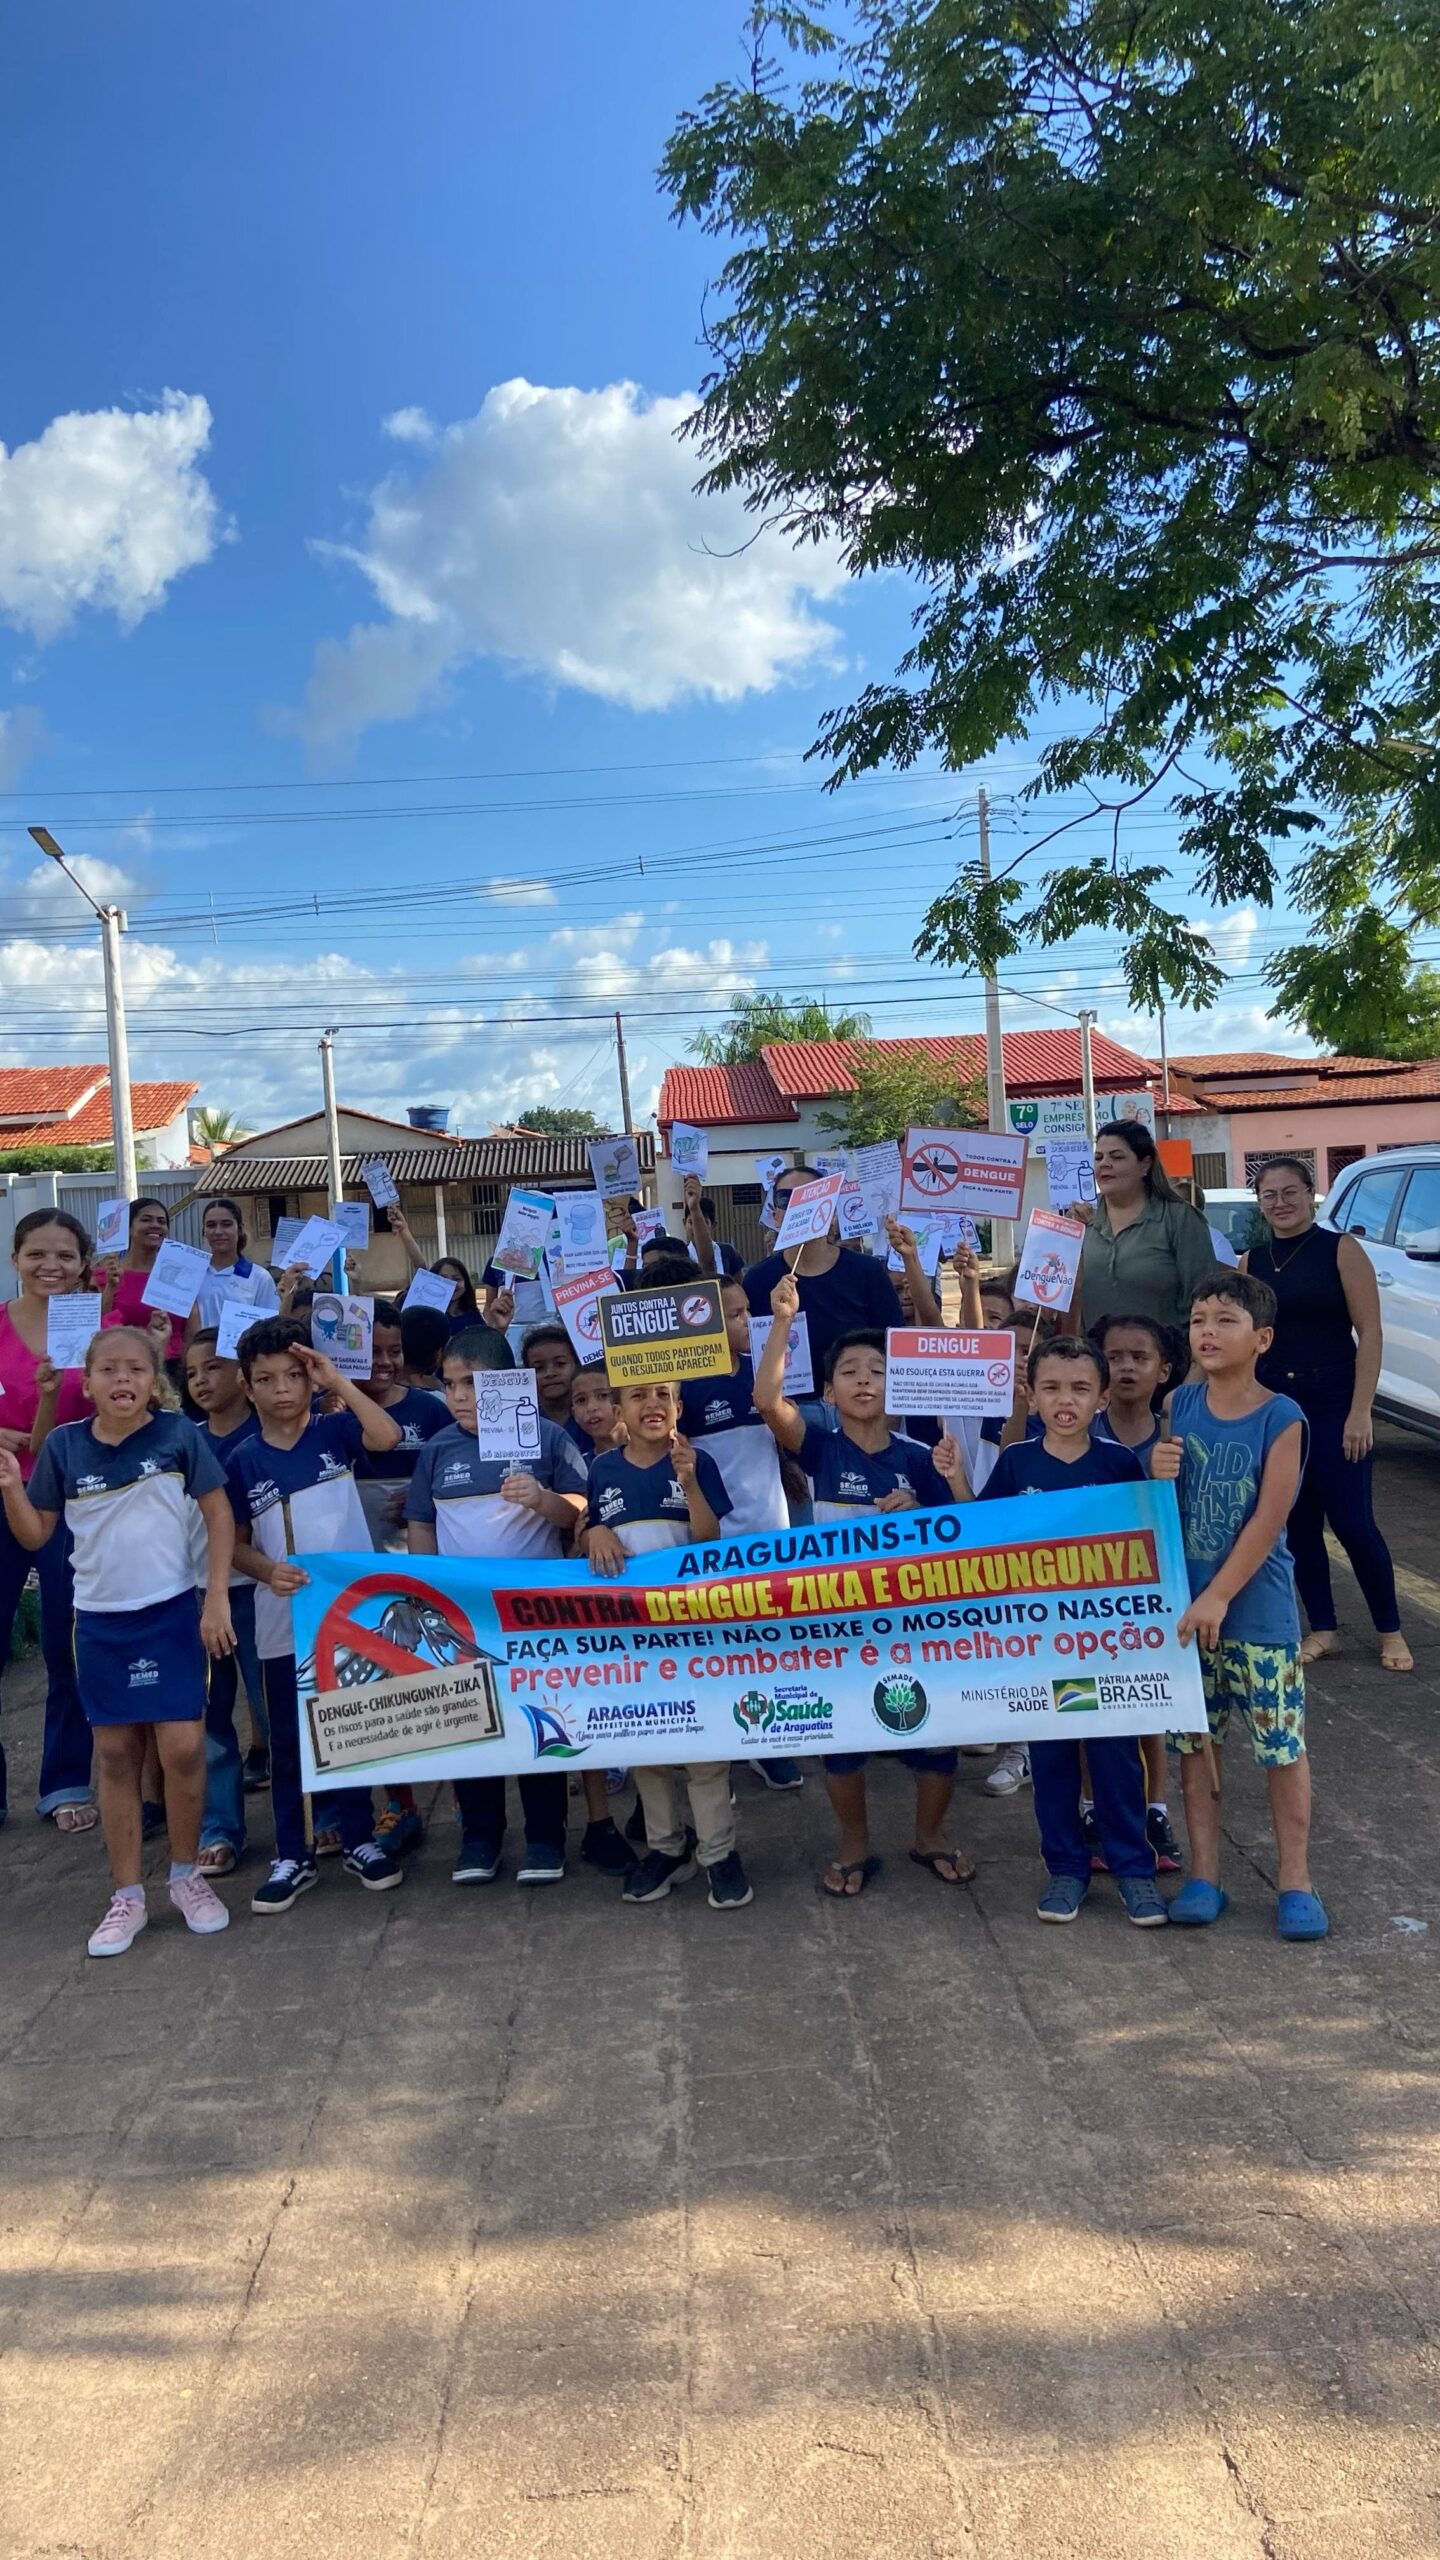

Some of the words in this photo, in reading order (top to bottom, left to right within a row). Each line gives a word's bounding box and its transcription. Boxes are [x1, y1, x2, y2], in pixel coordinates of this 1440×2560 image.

[1065, 1100, 1101, 1110] SEO
[1016, 1121, 1034, 1129] SELO
[1043, 1111, 1109, 1123] EMPRESMO
[965, 1153, 985, 1161] TODOS
[986, 1156, 1011, 1164] CONTRA
[963, 1167, 1016, 1182] DENGUE
[555, 1271, 612, 1301] PREVINA-SE
[611, 1302, 638, 1315] JUNTOS
[639, 1298, 668, 1312] CONTRA
[670, 1296, 676, 1307] A
[611, 1308, 680, 1338] DENGUE
[917, 1337, 980, 1354] DENGUE
[583, 1350, 605, 1364] DENG
[610, 1354, 643, 1368] QUANDO
[644, 1349, 671, 1362] TODOS
[622, 1366, 629, 1377] O
[630, 1362, 674, 1377] RESULTADO
[677, 1356, 716, 1370] APARECE!
[890, 1366, 904, 1376] NÃO
[906, 1368, 937, 1378] ESQUEÇA
[939, 1368, 955, 1376] ESTA
[957, 1369, 985, 1377] GUERRA
[250, 1487, 280, 1510] SEMED
[677, 1514, 961, 1578] ARAGUATINS-TO
[511, 1593, 641, 1626] CONTRA
[645, 1579, 783, 1622] DENGUE,
[788, 1570, 867, 1613] ZIKA
[870, 1567, 892, 1604] E
[899, 1539, 1153, 1601] CHIKUNGUNYA
[507, 1638, 569, 1662] FAÇA
[577, 1635, 626, 1654] SUA
[633, 1630, 714, 1650] PARTE!
[723, 1624, 781, 1645] NÃO
[790, 1620, 864, 1641] DEIXE
[872, 1618, 892, 1635] O
[903, 1603, 1048, 1633] MOSQUITO
[1058, 1594, 1172, 1620] NASCER.
[510, 1654, 648, 1693] Prevenir
[659, 1658, 677, 1680] e
[688, 1645, 848, 1678] combater
[860, 1639, 879, 1666] é
[890, 1642, 912, 1664] a
[921, 1631, 1042, 1663] melhor
[1054, 1621, 1165, 1661] opção
[883, 1673, 913, 1684] SEMADE
[1098, 1673, 1130, 1685] PÁTRIA
[1134, 1672, 1170, 1683] AMADA
[774, 1685, 807, 1693] Secretaria
[775, 1691, 808, 1700] Municipal
[961, 1687, 1028, 1701] MINISTÉRIO
[1031, 1686, 1048, 1698] DA
[1100, 1683, 1172, 1703] BRASIL
[587, 1700, 696, 1722] ARAGUATINS
[775, 1697, 833, 1722] Saúde
[1008, 1698, 1049, 1713] SAÚDE
[324, 1726, 336, 1737] Os
[338, 1722, 363, 1734] riscos
[365, 1716, 385, 1729] para
[387, 1716, 393, 1724] a
[395, 1708, 422, 1723] saúde
[424, 1705, 440, 1716] são
[587, 1720, 642, 1730] PREFEITURA
[645, 1717, 698, 1726] MUNICIPAL
[770, 1723, 781, 1733] de
[783, 1720, 833, 1734] Araguatins
[337, 1742, 343, 1750] a
[344, 1728, 400, 1749] necessidade
[403, 1724, 414, 1735] de
[416, 1722, 433, 1735] agir
[436, 1718, 442, 1729] é
[741, 1737, 759, 1745] Cuidar
